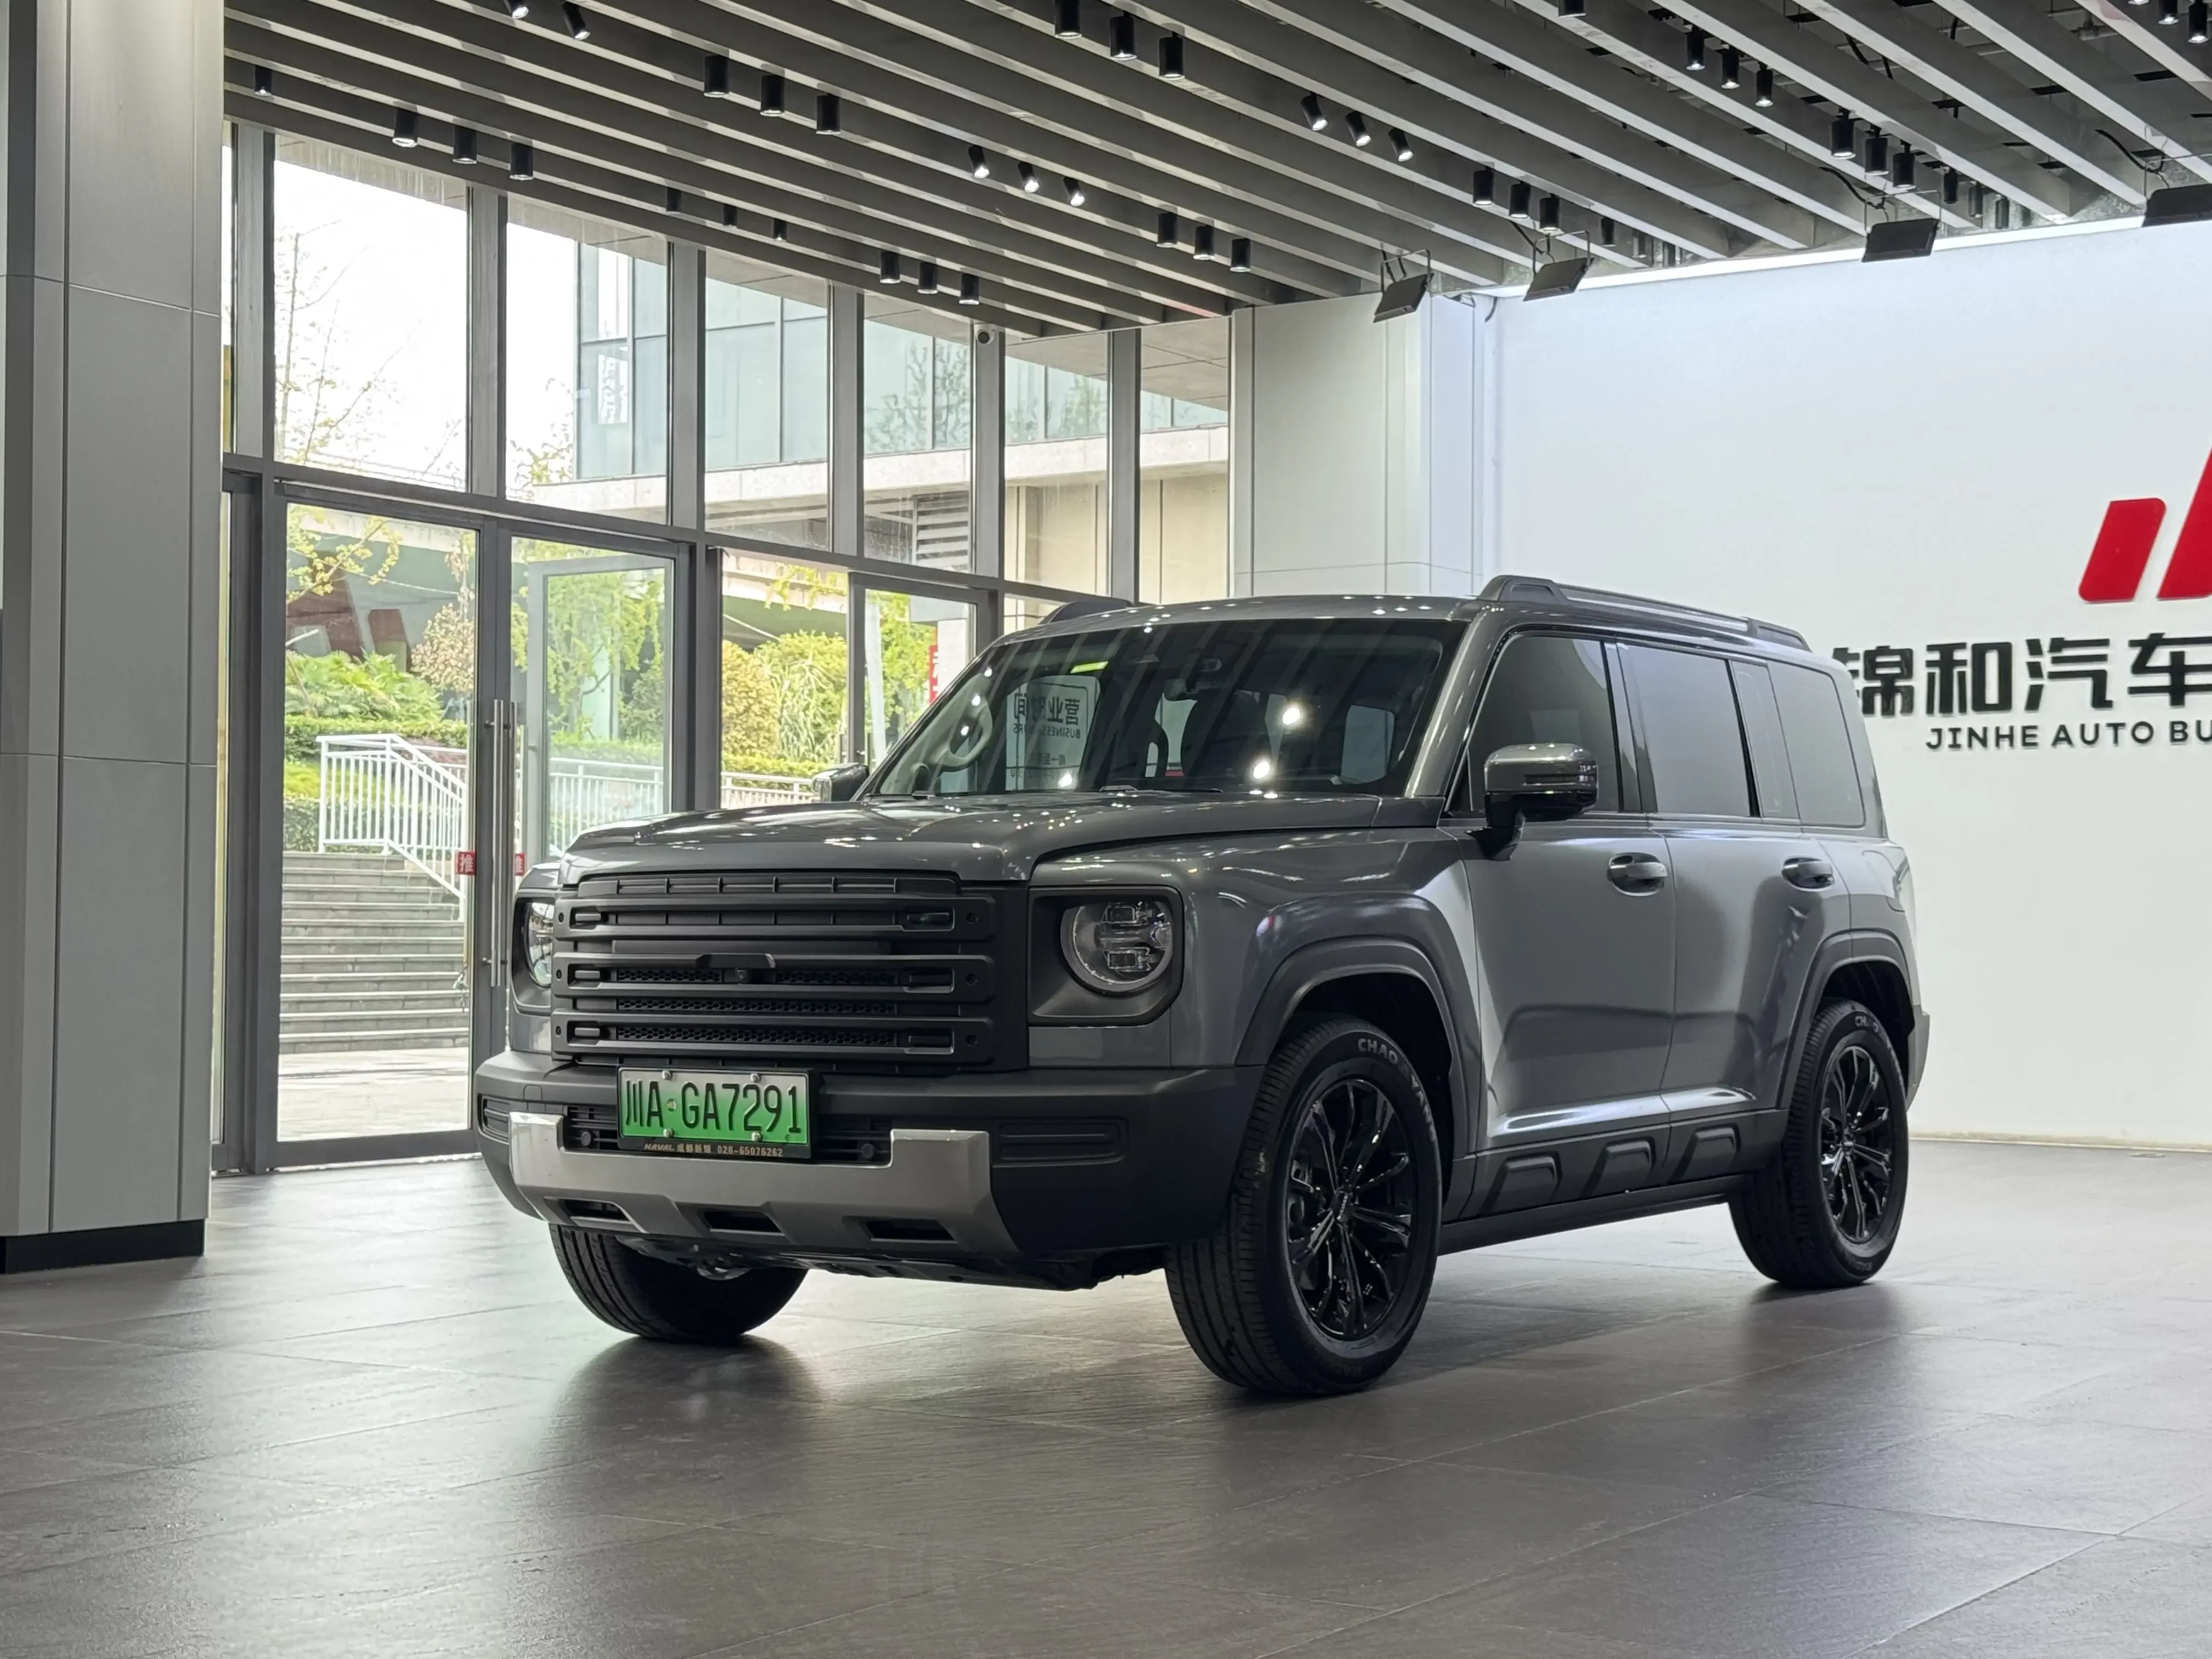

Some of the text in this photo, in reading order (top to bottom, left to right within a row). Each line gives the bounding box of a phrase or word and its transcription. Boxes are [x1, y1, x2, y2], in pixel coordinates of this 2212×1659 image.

[1833, 633, 2212, 716] 锦和汽车
[1925, 719, 2212, 750] JINHE AUTO BU
[460, 853, 475, 873] 推
[644, 1143, 675, 1151] HAVAL
